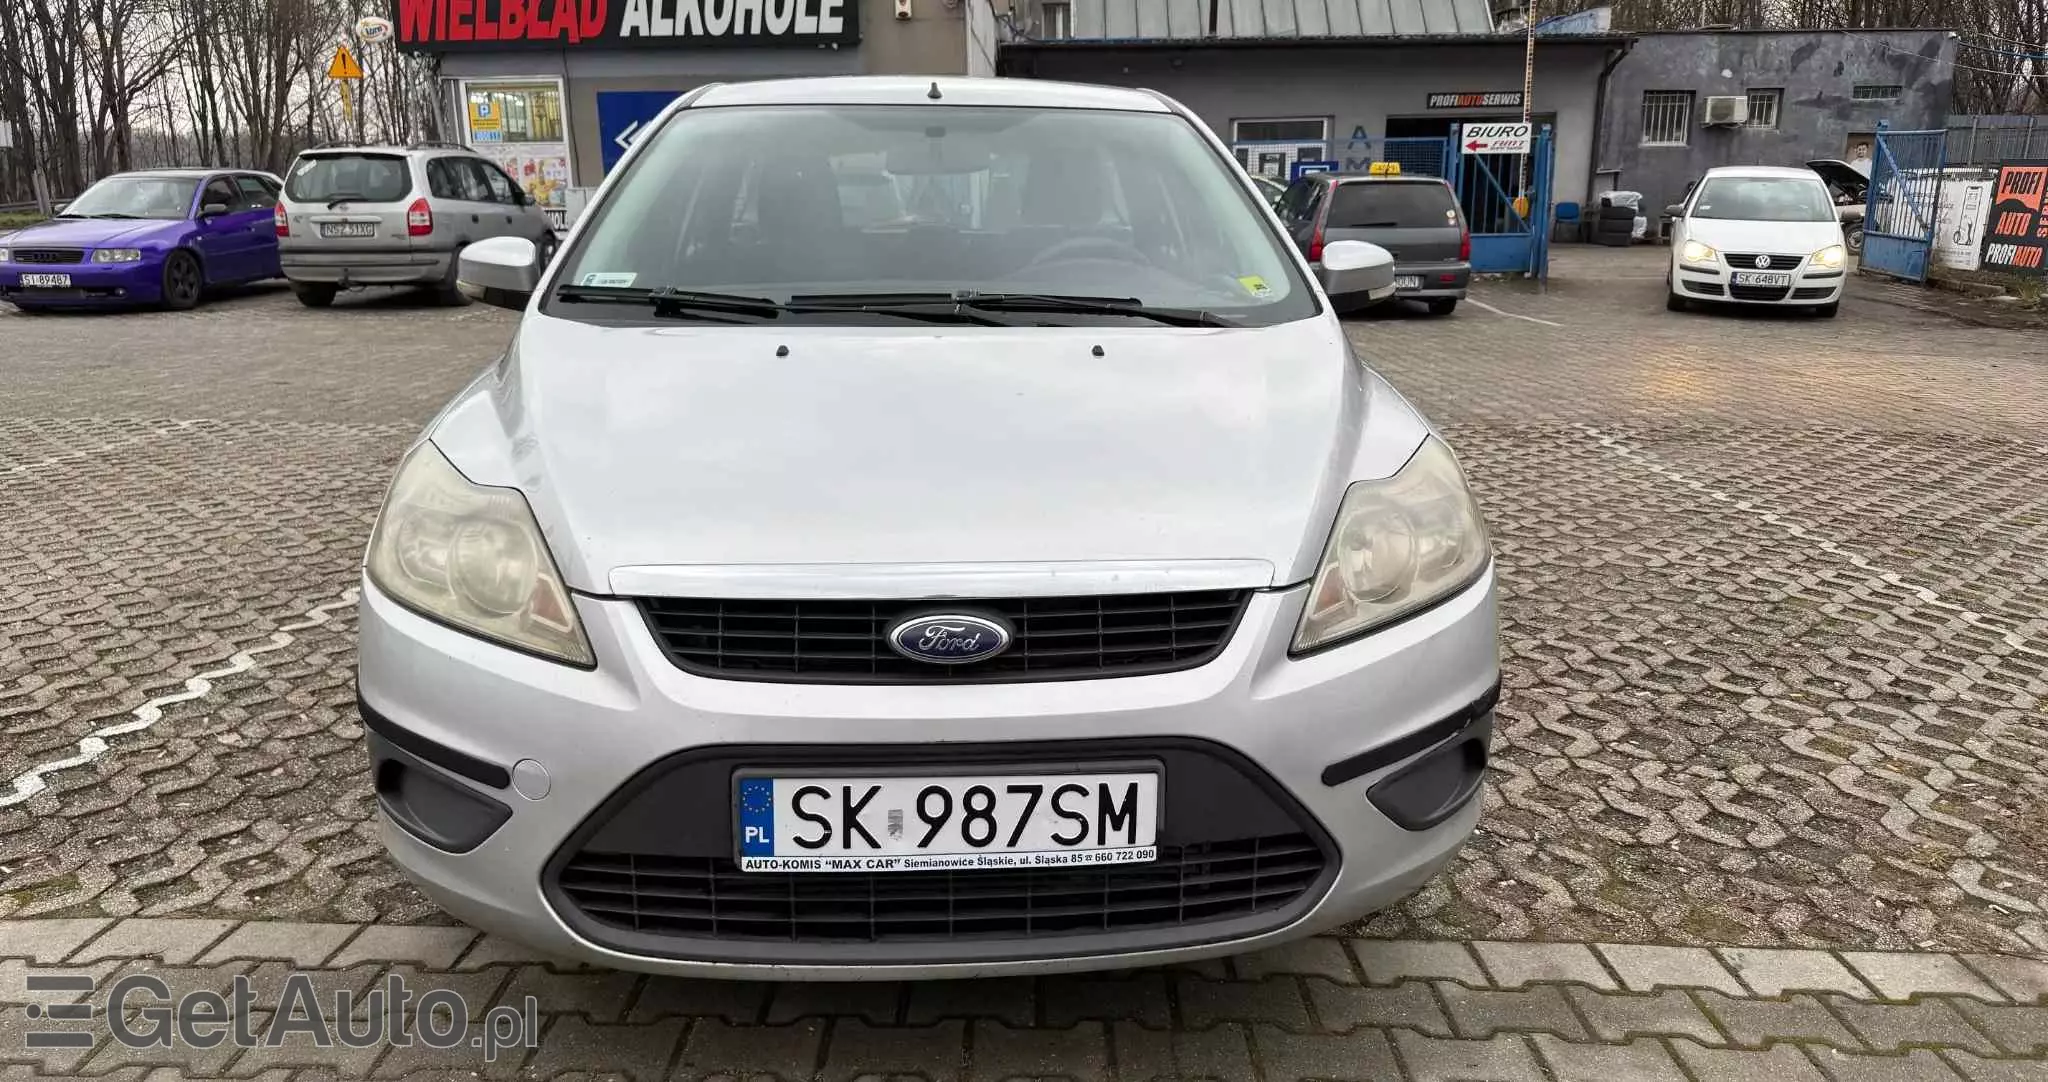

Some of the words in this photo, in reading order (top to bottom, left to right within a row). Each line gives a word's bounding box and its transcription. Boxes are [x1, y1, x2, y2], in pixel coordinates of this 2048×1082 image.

[1430, 93, 1521, 107] PROFIAUTOSERWIS
[1467, 125, 1529, 138] BIURO
[2001, 171, 2042, 194] PROFI
[1994, 211, 2032, 236] AUTO
[1984, 243, 2043, 268] PROFIAUTO
[1739, 273, 1753, 284] SK
[918, 625, 981, 651] Ford
[791, 785, 882, 849] SK
[916, 782, 1139, 849] 987SM
[745, 826, 769, 844] PL
[745, 859, 821, 870] AUTO-KOMIS
[904, 857, 974, 869] Siemianowice
[1020, 855, 1032, 865] ul.
[1071, 854, 1083, 863] 85
[1095, 853, 1113, 862] 660
[1116, 851, 1134, 860] 722
[1136, 850, 1154, 860] 090
